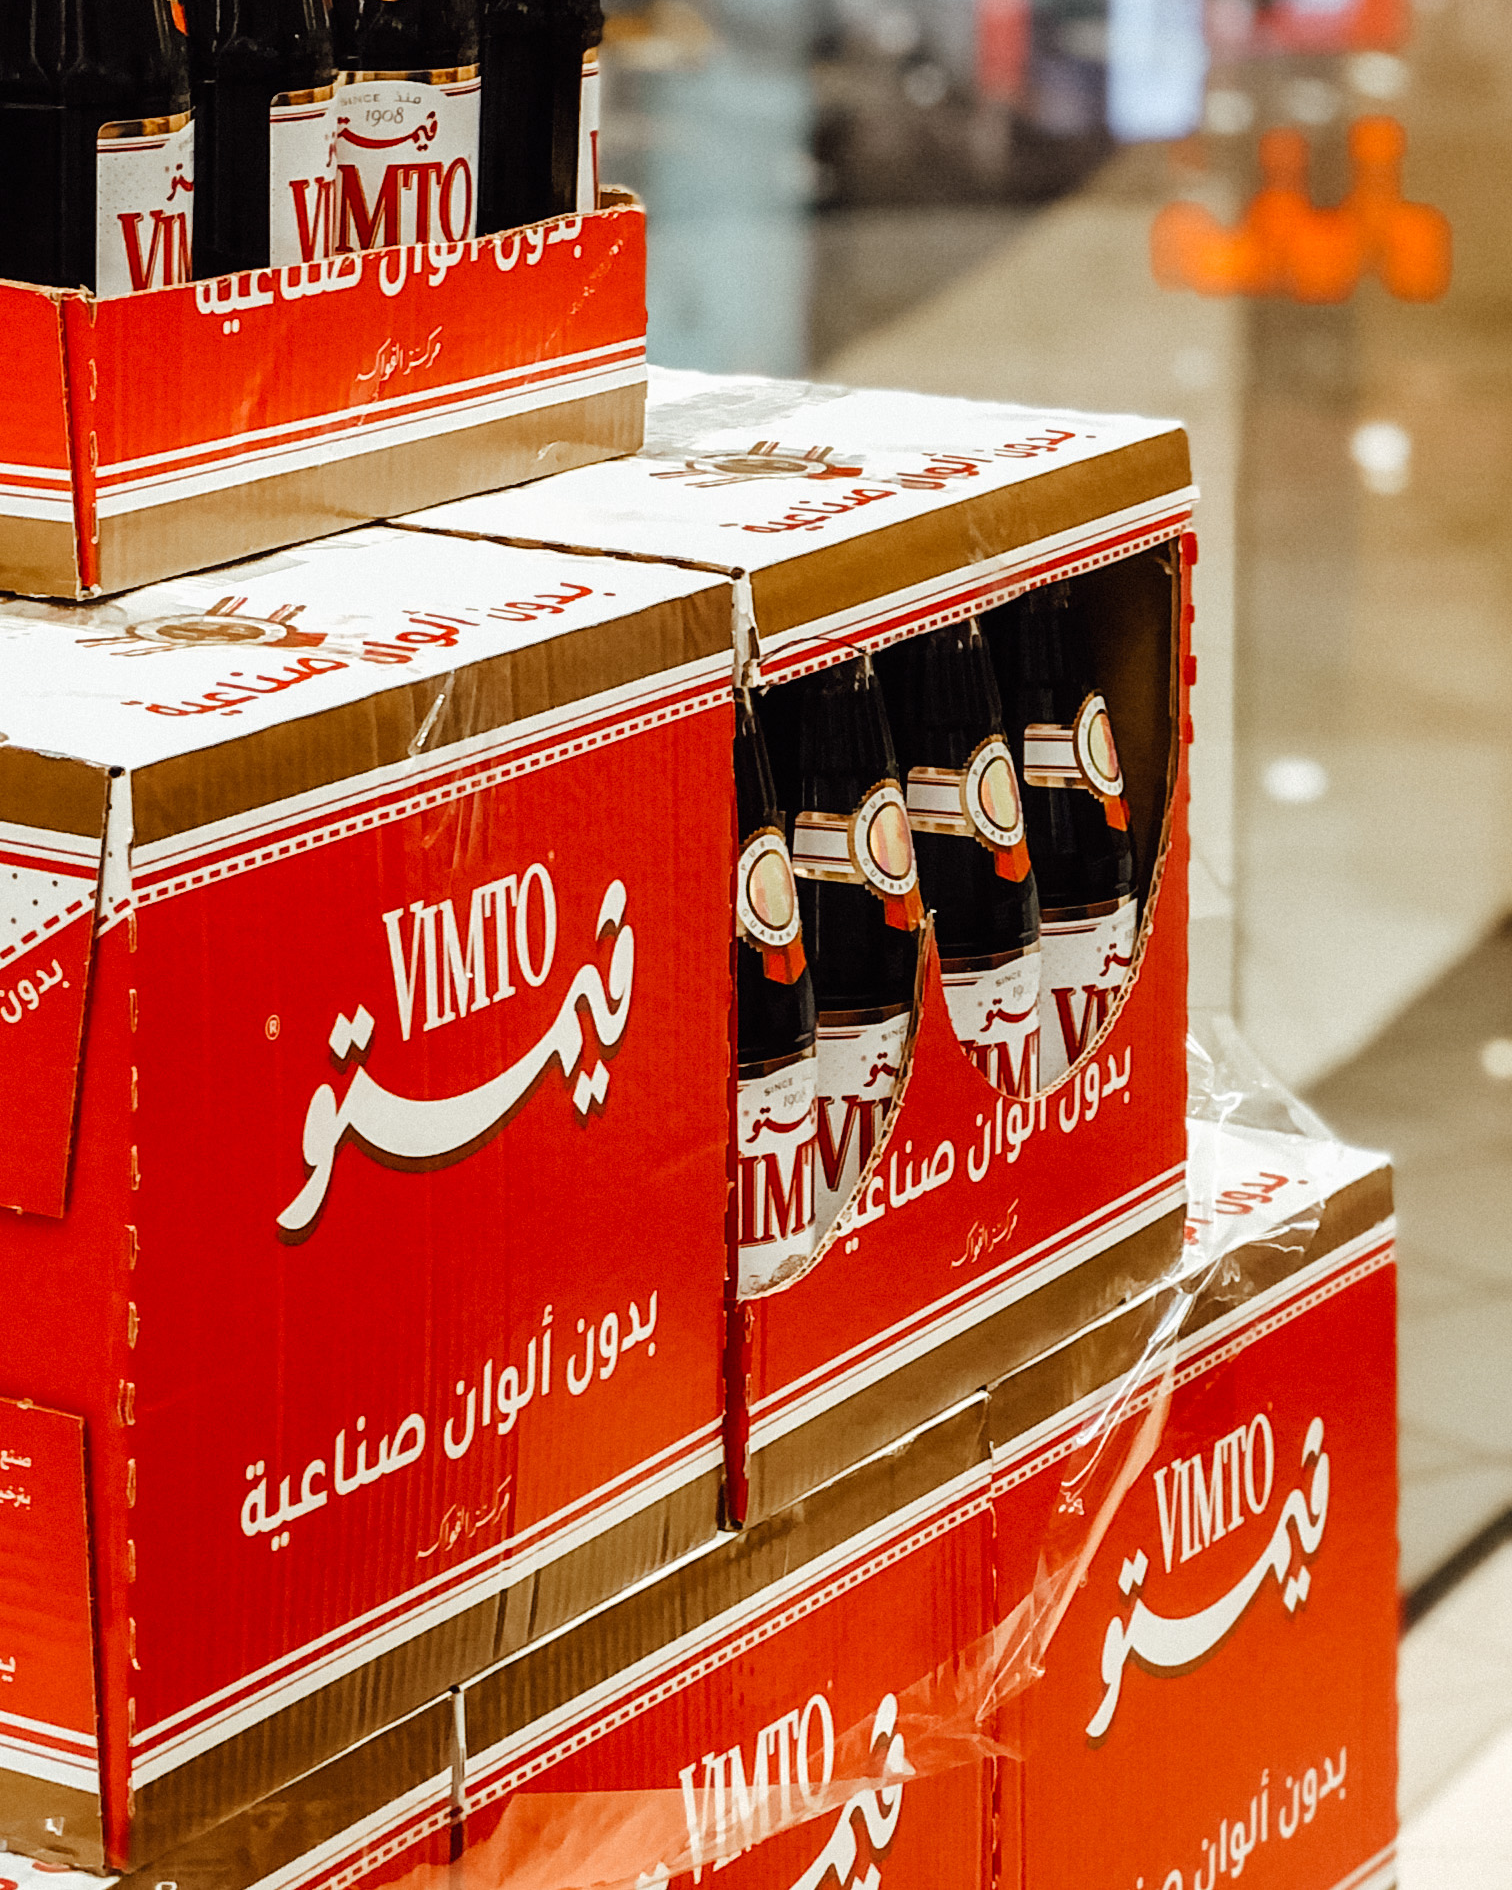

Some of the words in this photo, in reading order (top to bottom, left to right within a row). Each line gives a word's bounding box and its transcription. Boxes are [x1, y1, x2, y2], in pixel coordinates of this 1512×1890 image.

[365, 109, 404, 127] 1908
[0, 959, 70, 1024] بدون
[382, 862, 558, 1042] VIMTO
[276, 879, 635, 1232] فيمتو
[444, 1304, 553, 1460] ألوان
[567, 1290, 658, 1396] بدون
[0, 1449, 32, 1470] صنع
[241, 1412, 427, 1552] صناعية
[1153, 1413, 1275, 1574] VIMTO
[1085, 1417, 1330, 1738] فيمتو
[678, 1693, 834, 1885] VIMTO
[1194, 1768, 1269, 1890] ألوان
[1279, 1745, 1347, 1839] بدون
